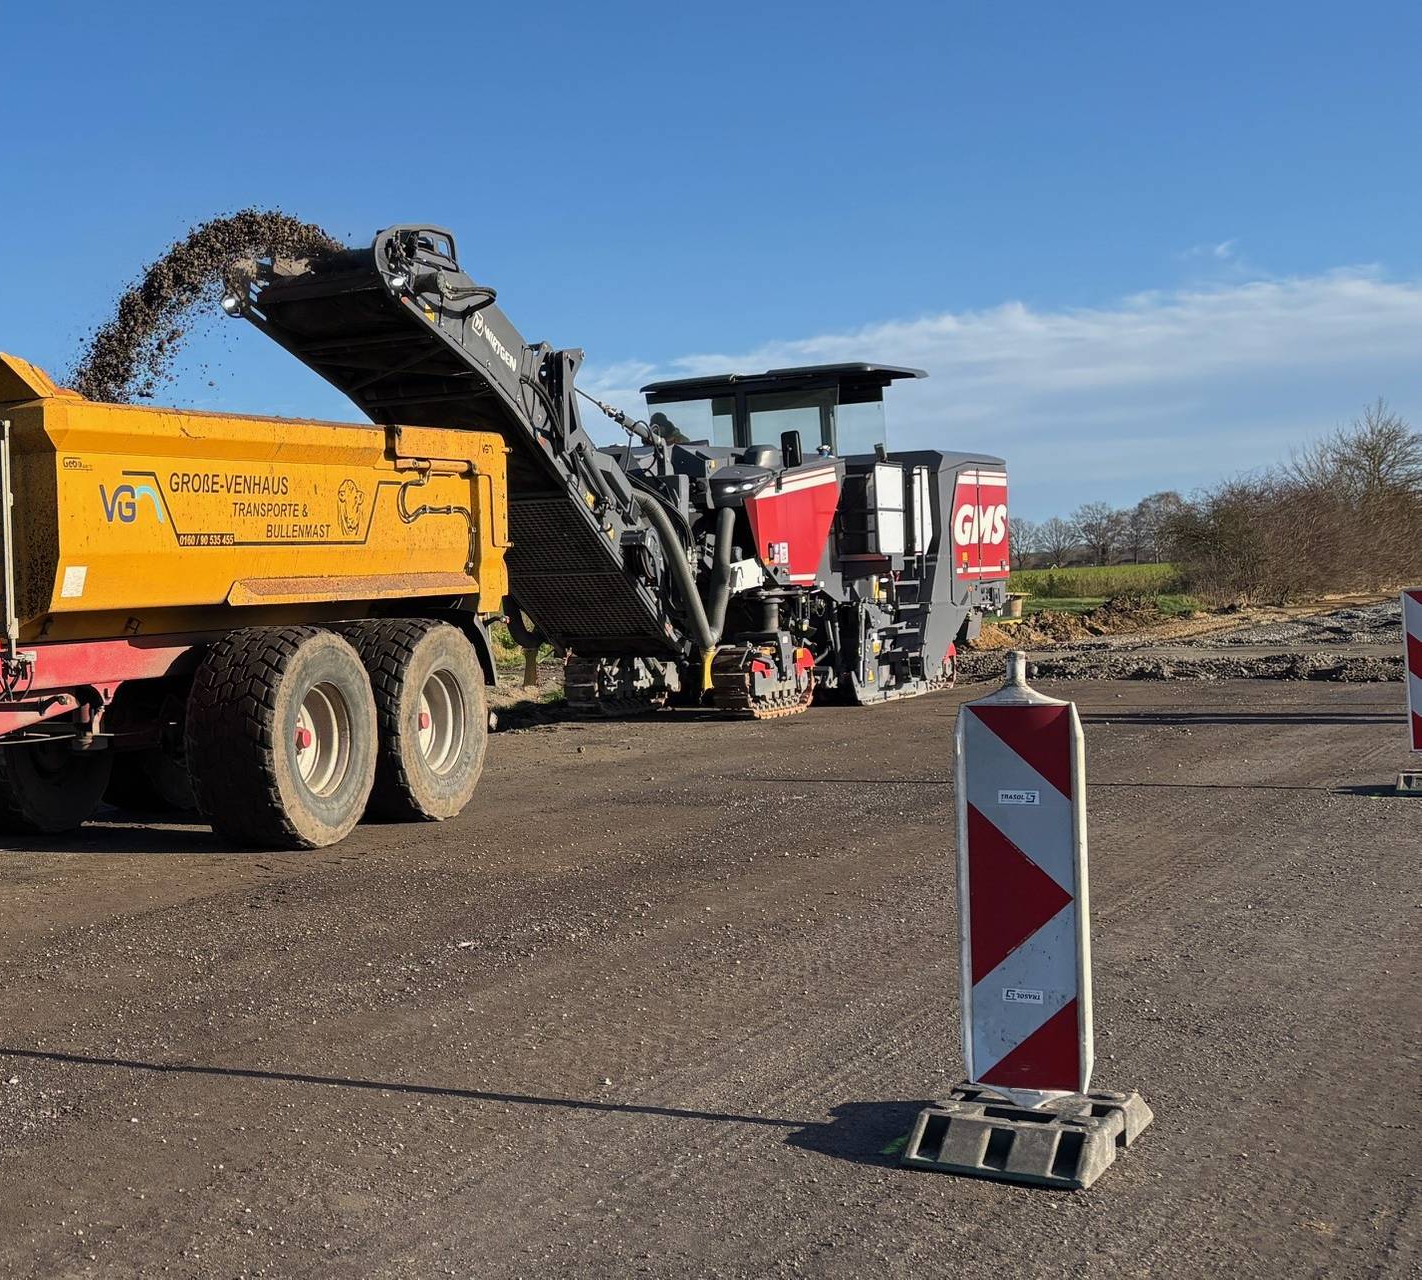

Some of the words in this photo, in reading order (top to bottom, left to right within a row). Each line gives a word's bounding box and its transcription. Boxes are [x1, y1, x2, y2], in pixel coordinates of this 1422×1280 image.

[484, 324, 517, 372] WIRTGEN
[169, 472, 289, 495] GROßE-VENHAUS
[232, 502, 299, 517] TRANSPORTE
[302, 504, 309, 518] &
[266, 524, 331, 538] BULLENMAST
[954, 504, 1007, 546] GMS
[209, 534, 221, 545] 535
[221, 534, 234, 545] 455
